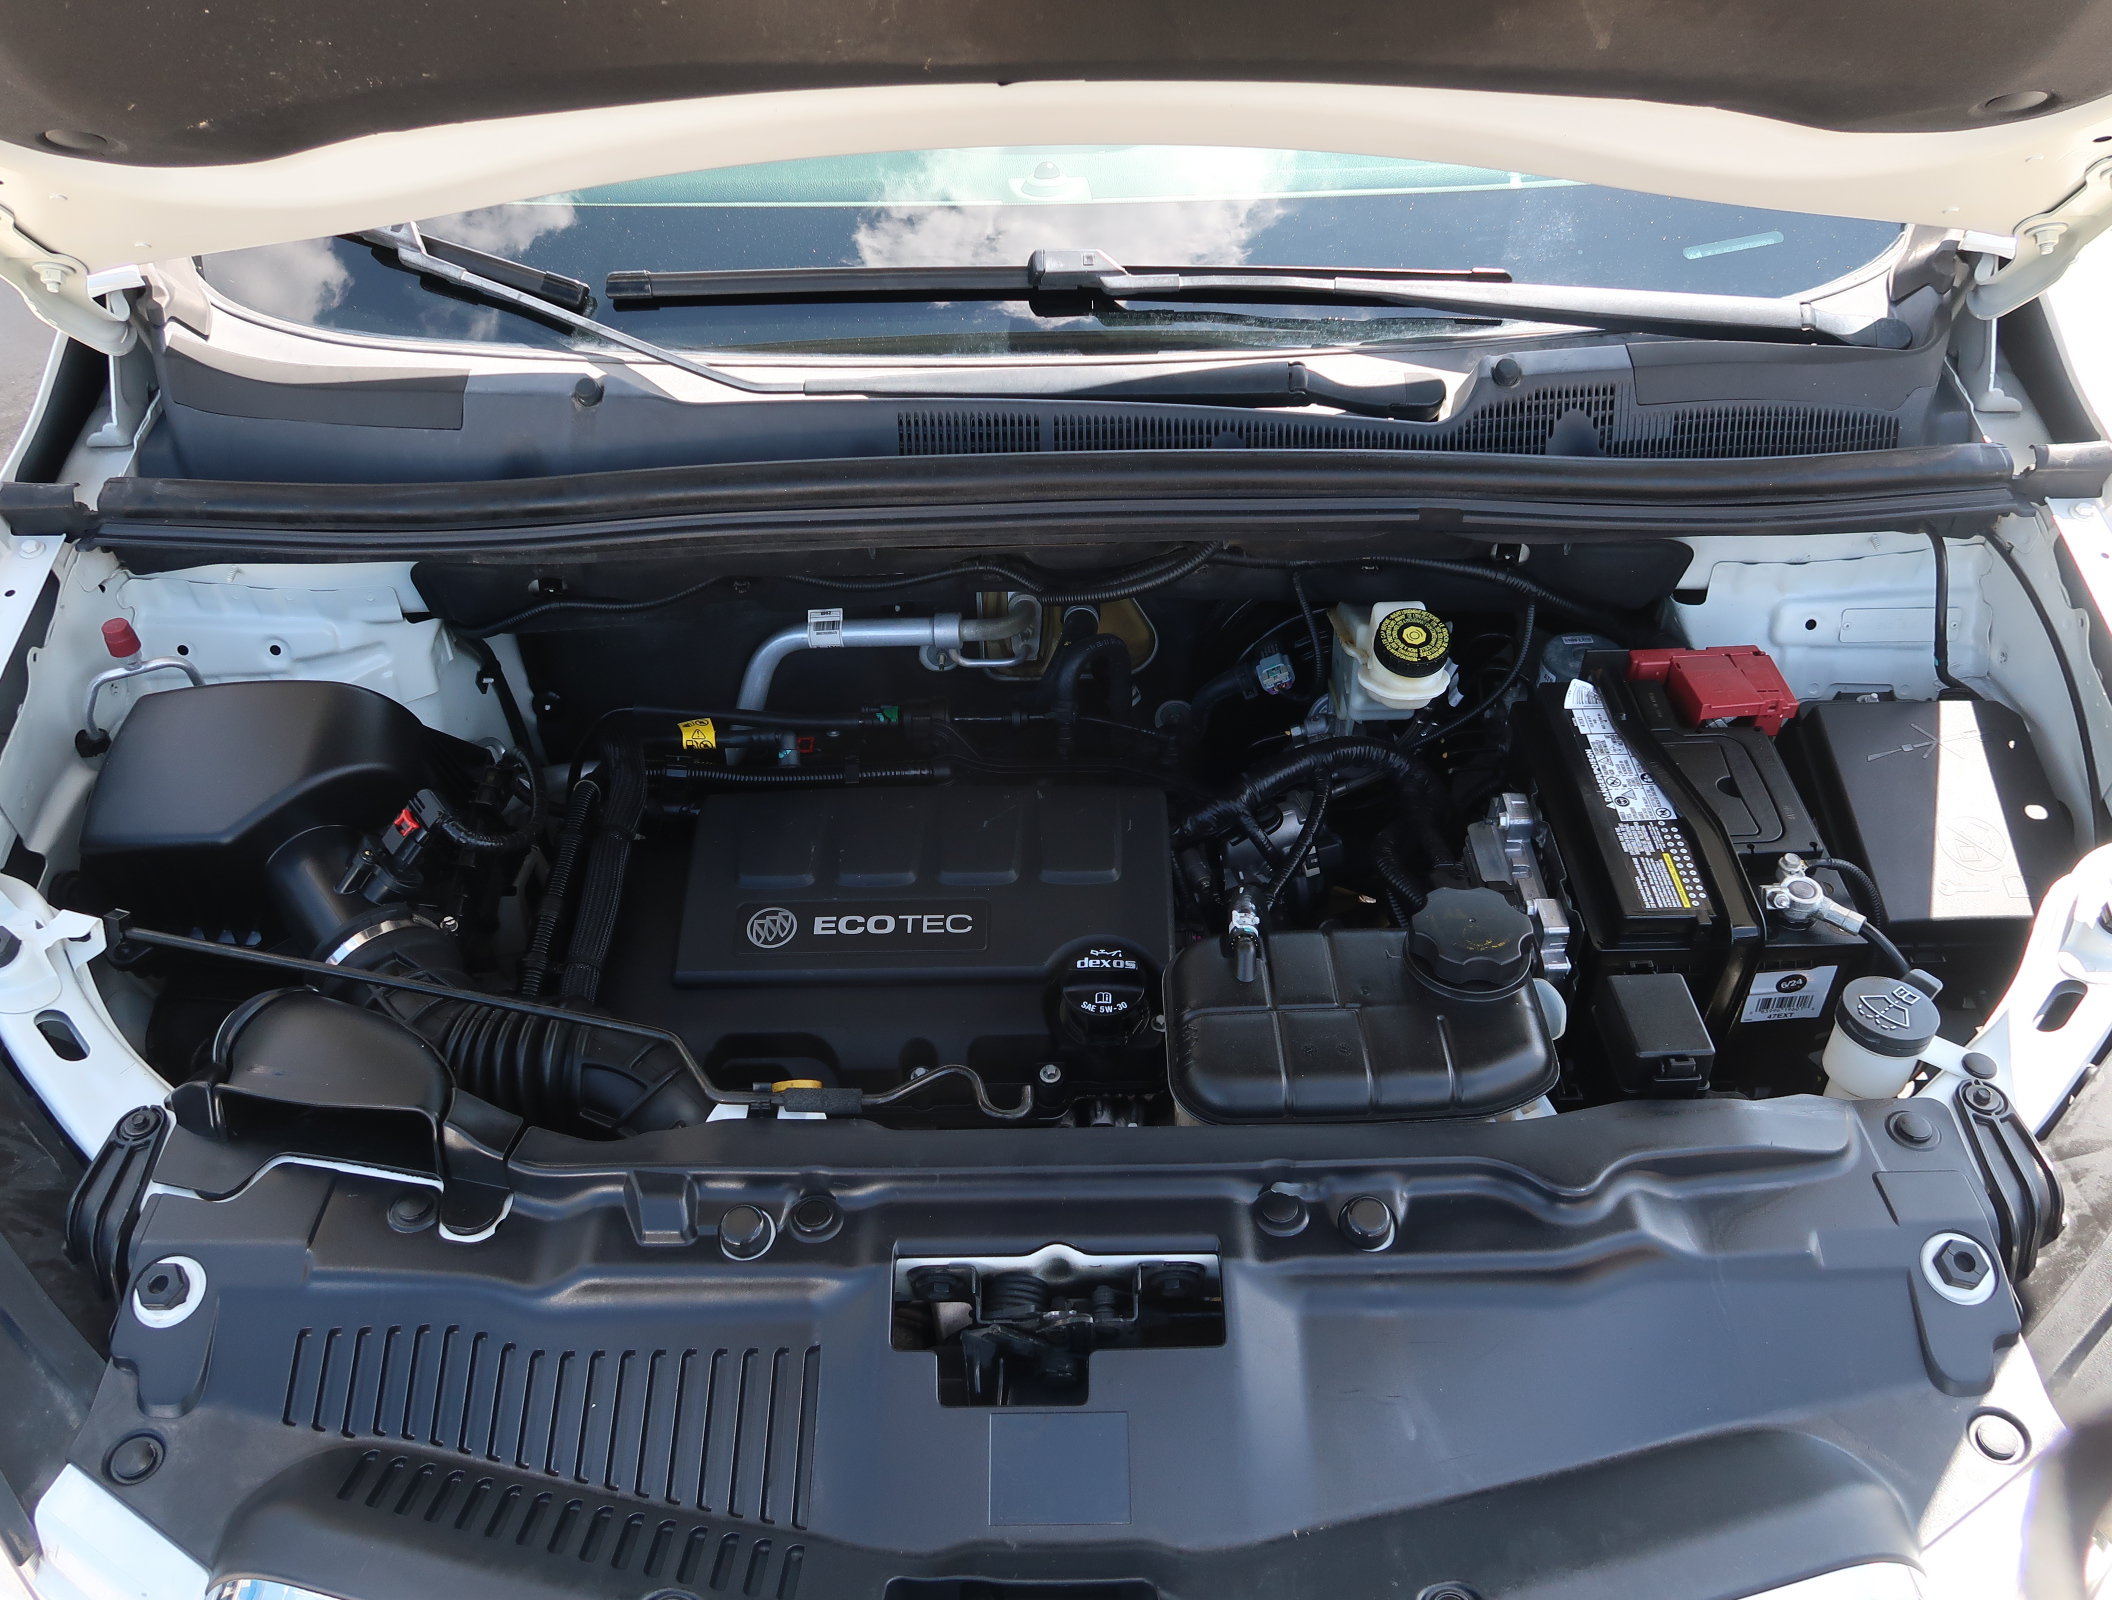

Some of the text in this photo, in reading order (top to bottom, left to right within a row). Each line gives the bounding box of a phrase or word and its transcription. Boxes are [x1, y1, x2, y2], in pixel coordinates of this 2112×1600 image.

[813, 914, 973, 935] ECOTEC
[1076, 957, 1137, 969] dexos
[1780, 978, 1803, 989] 6/24
[1081, 1001, 1128, 1014] SAE 5W-30
